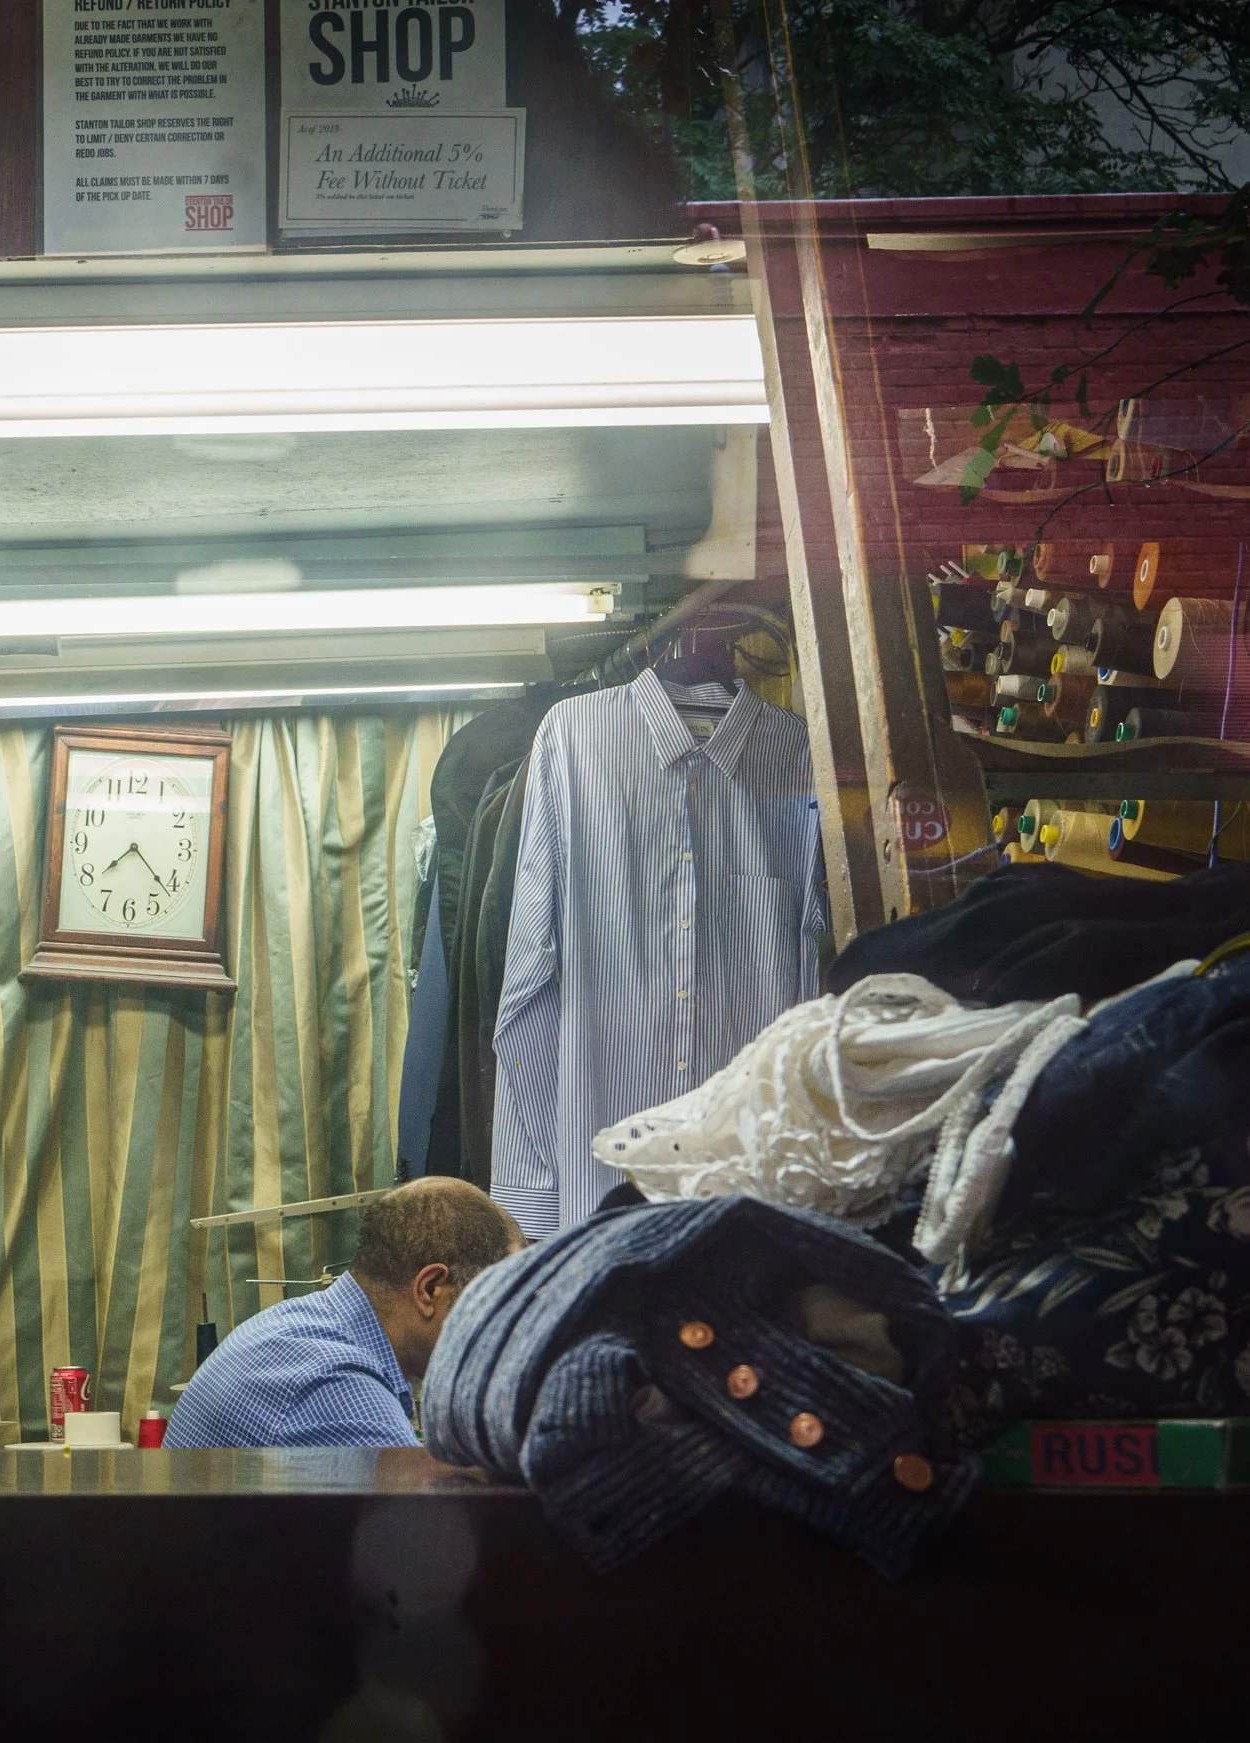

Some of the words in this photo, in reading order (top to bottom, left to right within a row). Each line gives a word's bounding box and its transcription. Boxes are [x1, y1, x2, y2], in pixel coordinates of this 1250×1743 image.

[74, 0, 122, 11] REFUND
[137, 0, 186, 10] RETURN
[74, 21, 89, 31] DUE
[91, 21, 100, 30] TO
[101, 20, 116, 30] THE
[117, 20, 135, 30] FACT
[137, 19, 155, 29] THAT
[157, 19, 169, 29] WE
[170, 18, 192, 28] WORK
[194, 18, 212, 28] WITH
[74, 35, 107, 45] ALREADY
[109, 34, 130, 44] MADE
[131, 33, 172, 43] GARMENTS
[173, 33, 185, 42] WE
[186, 32, 206, 42] HAVE
[207, 32, 218, 41] NO
[309, 6, 475, 85] SHOP
[74, 49, 103, 59] REFUND
[133, 48, 141, 57] IF
[142, 48, 156, 57] YOU
[157, 47, 172, 57] ARE
[173, 47, 188, 56] NOT
[189, 46, 226, 56] SATISFIED
[75, 63, 94, 73] WITH
[94, 63, 110, 72] THE
[158, 61, 170, 71] WE
[171, 61, 189, 70] WILL
[190, 61, 200, 70] DO
[202, 60, 217, 70] OUR
[75, 77, 94, 87] BEST
[95, 77, 105, 86] TO
[106, 77, 120, 86] TRY
[122, 76, 132, 86] TO
[133, 76, 166, 85] CORRECT
[167, 75, 182, 85] THE
[183, 74, 218, 84] PROBLEM
[219, 74, 227, 84] IN
[75, 91, 89, 101] THE
[91, 91, 126, 101] GARMENT
[128, 90, 147, 100] WITH
[148, 90, 169, 99] WHAT
[171, 89, 178, 99] IS
[75, 120, 108, 130] STANTON
[110, 119, 135, 129] TAILOR
[137, 119, 156, 128] SHOP
[158, 118, 195, 128] RESERVES
[196, 117, 211, 127] THE
[212, 117, 234, 127] RIGHT
[75, 134, 85, 144] TO
[86, 134, 106, 144] LIMIT
[114, 133, 134, 143] DENY
[135, 133, 166, 143] CERTAIN
[167, 132, 213, 142] CORRECTION
[214, 132, 224, 141] OR
[76, 149, 95, 158] REDO
[315, 143, 343, 162] An
[347, 143, 443, 163] Additional
[448, 143, 483, 163] 5%
[76, 178, 89, 187] ALL
[91, 177, 118, 187] CLAIMS
[120, 176, 140, 186] MUST
[142, 176, 151, 186] BE
[153, 176, 174, 185] MADE
[175, 175, 202, 185] WITHIN
[204, 175, 209, 184] 7
[210, 175, 229, 184] DAYS
[316, 170, 345, 190] Fee
[353, 170, 426, 190] Without
[433, 170, 487, 190] Ticket
[76, 192, 85, 202] OF
[86, 192, 101, 201] THE
[102, 191, 119, 201] PICK
[121, 191, 131, 201] UP
[185, 205, 234, 228] SHOP
[108, 778, 121, 801] 11
[127, 770, 148, 795] 12
[84, 804, 105, 827] 10
[172, 807, 186, 829] 2
[74, 831, 88, 854] 9
[178, 838, 192, 861] 3
[80, 863, 95, 886] 8
[166, 869, 181, 892] 4
[100, 889, 113, 912] 7
[122, 898, 136, 922] 6
[146, 892, 160, 916] 5
